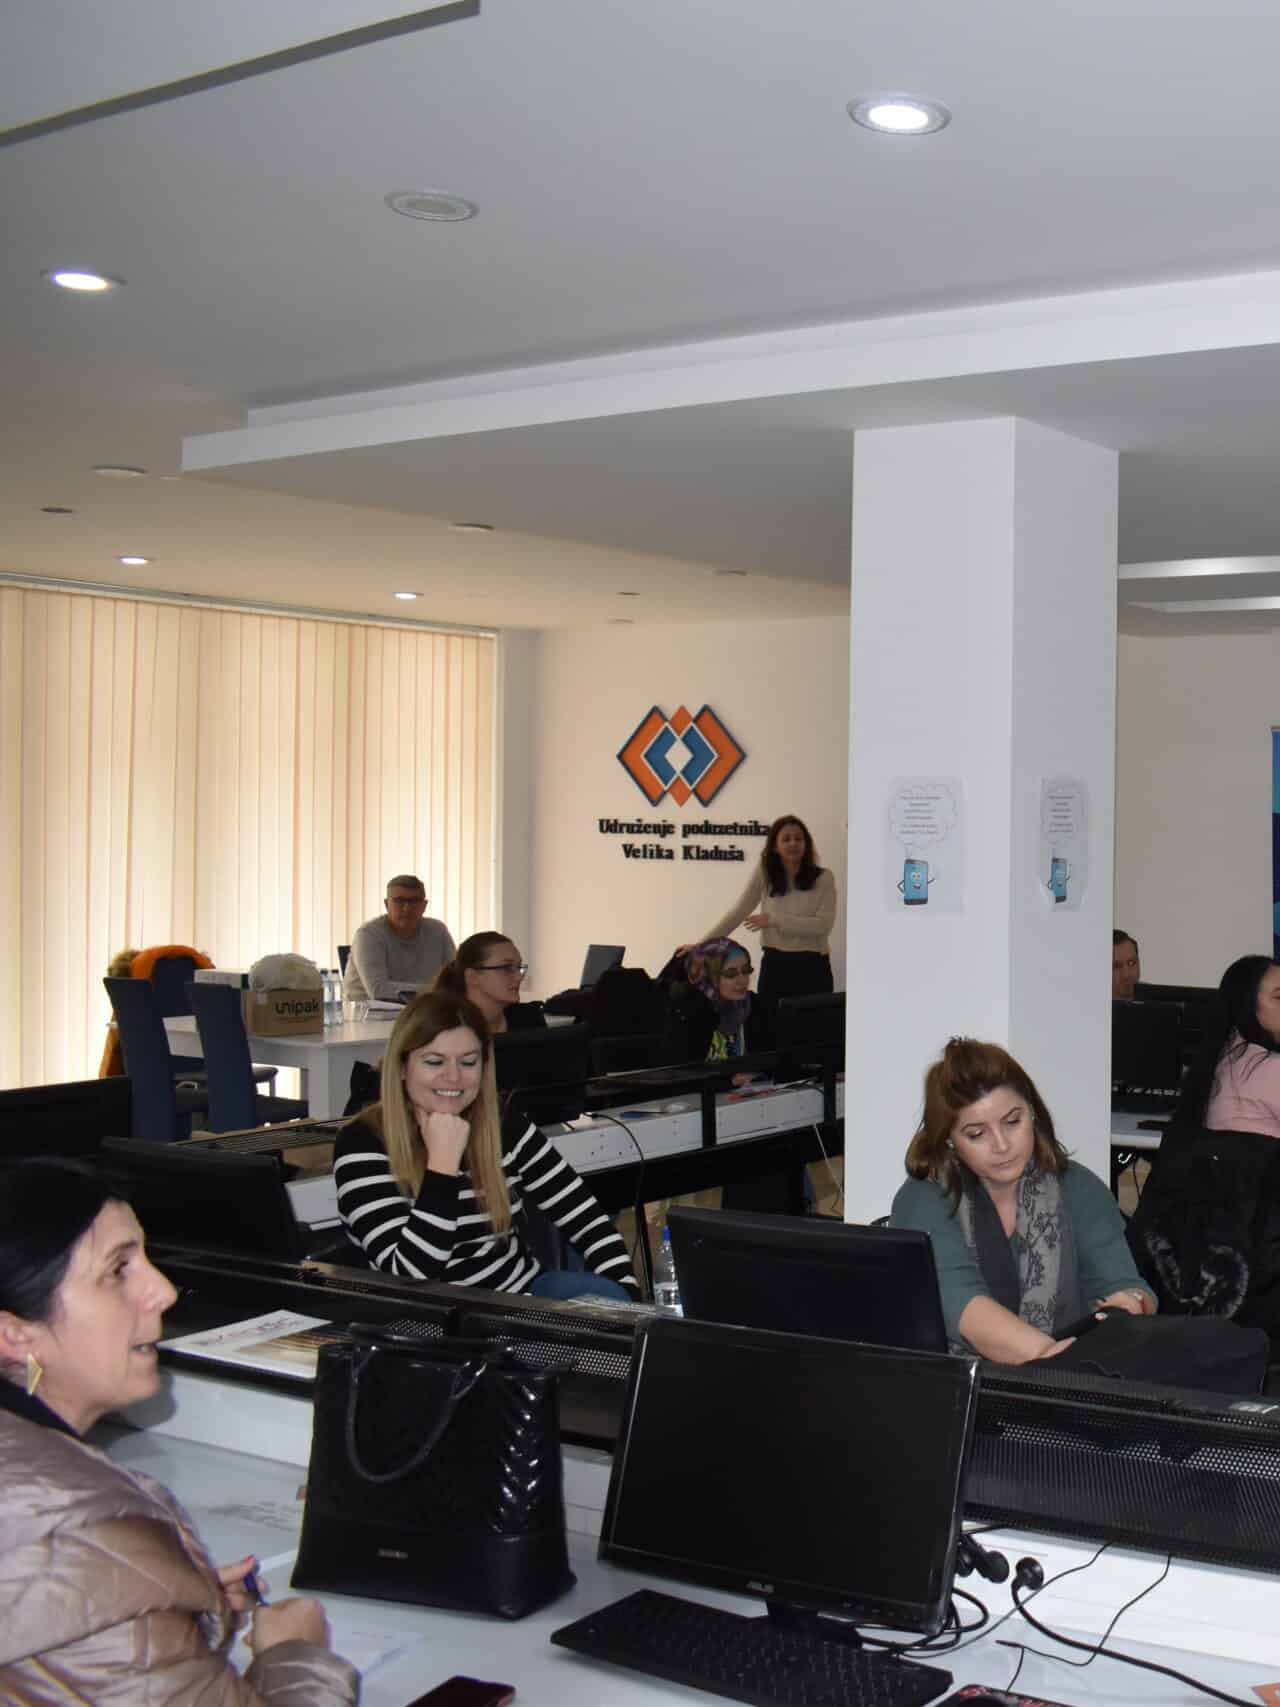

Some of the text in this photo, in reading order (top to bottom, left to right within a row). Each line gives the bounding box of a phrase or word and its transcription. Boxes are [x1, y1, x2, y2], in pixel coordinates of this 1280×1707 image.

[599, 819, 676, 838] Udruženje
[622, 843, 745, 861] Velika Kladuša
[275, 998, 319, 1017] unipak
